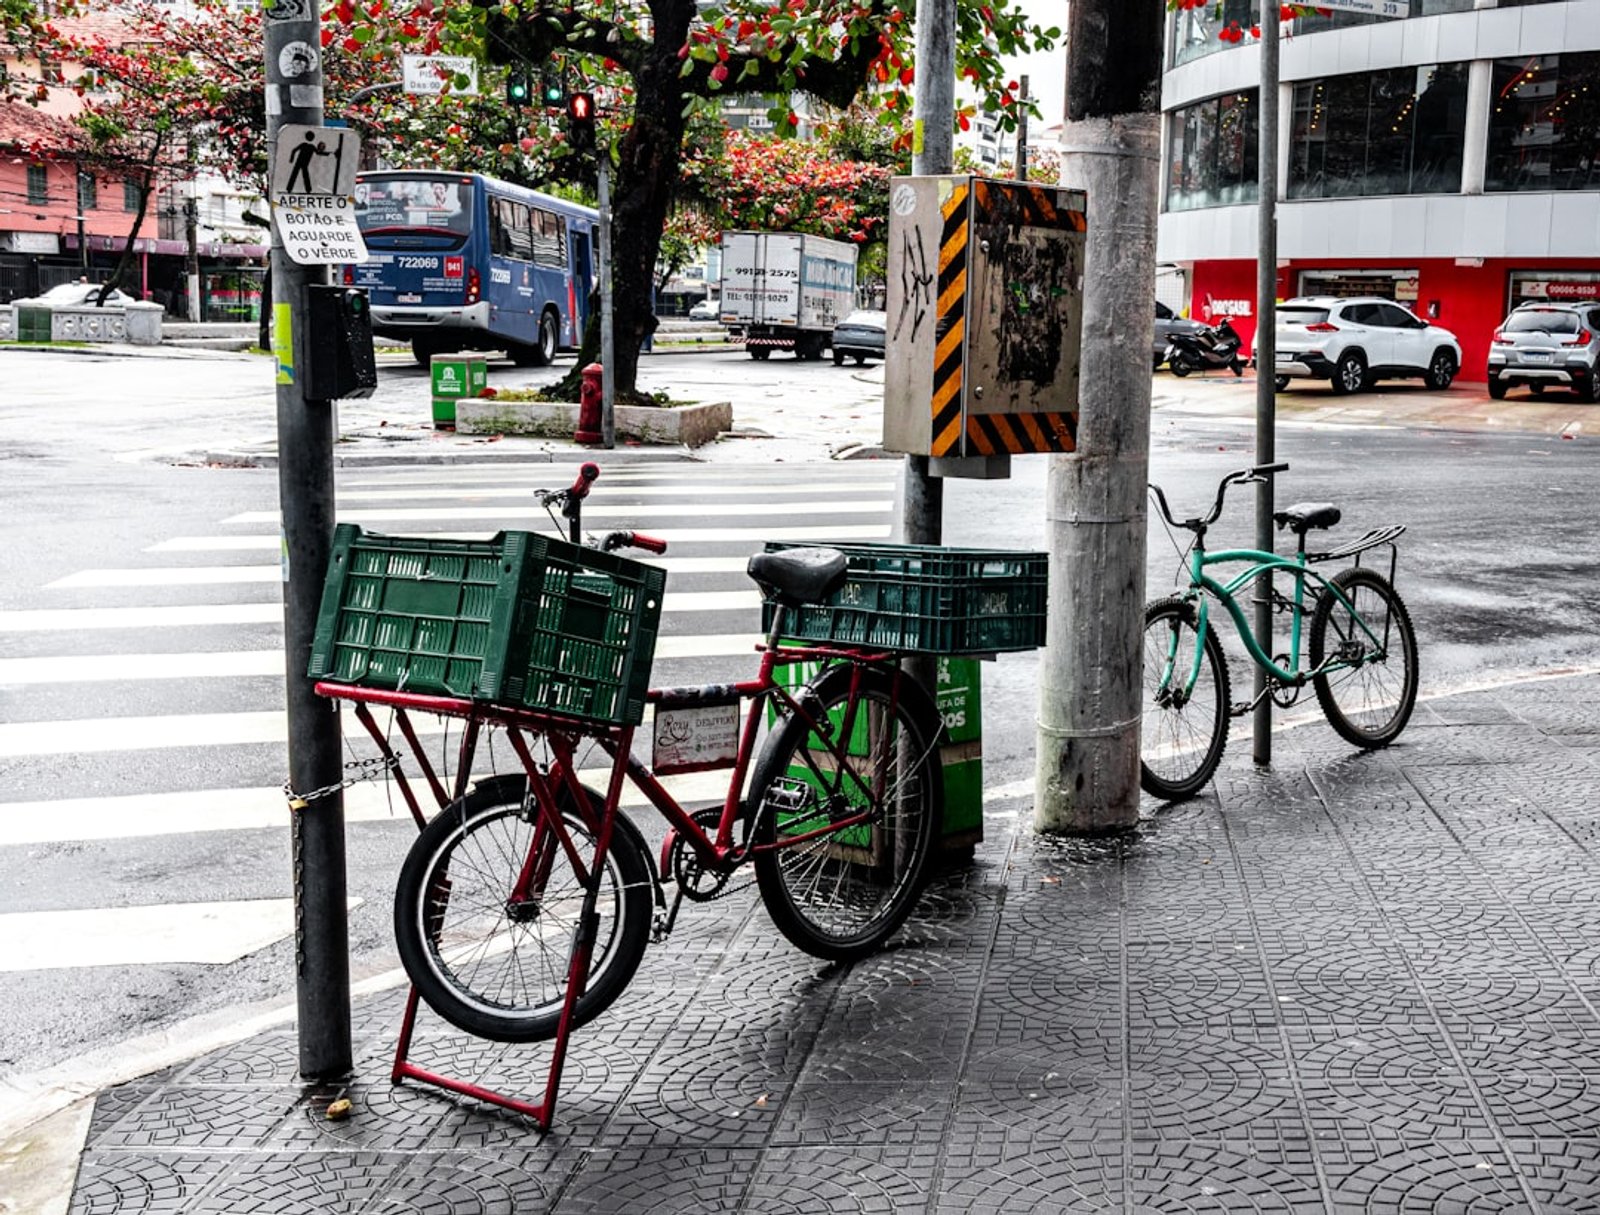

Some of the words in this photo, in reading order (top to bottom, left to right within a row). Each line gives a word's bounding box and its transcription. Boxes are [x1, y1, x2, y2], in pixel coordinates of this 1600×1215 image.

[280, 196, 333, 209] APERTE
[336, 196, 347, 209] O
[335, 215, 345, 226] E
[289, 230, 355, 242] AGUARDE
[298, 247, 309, 259] O
[311, 247, 358, 259] VERDE
[398, 256, 439, 269] 722069
[447, 262, 461, 271] 941
[954, 696, 966, 707] DE
[695, 715, 737, 728] DELIVERY
